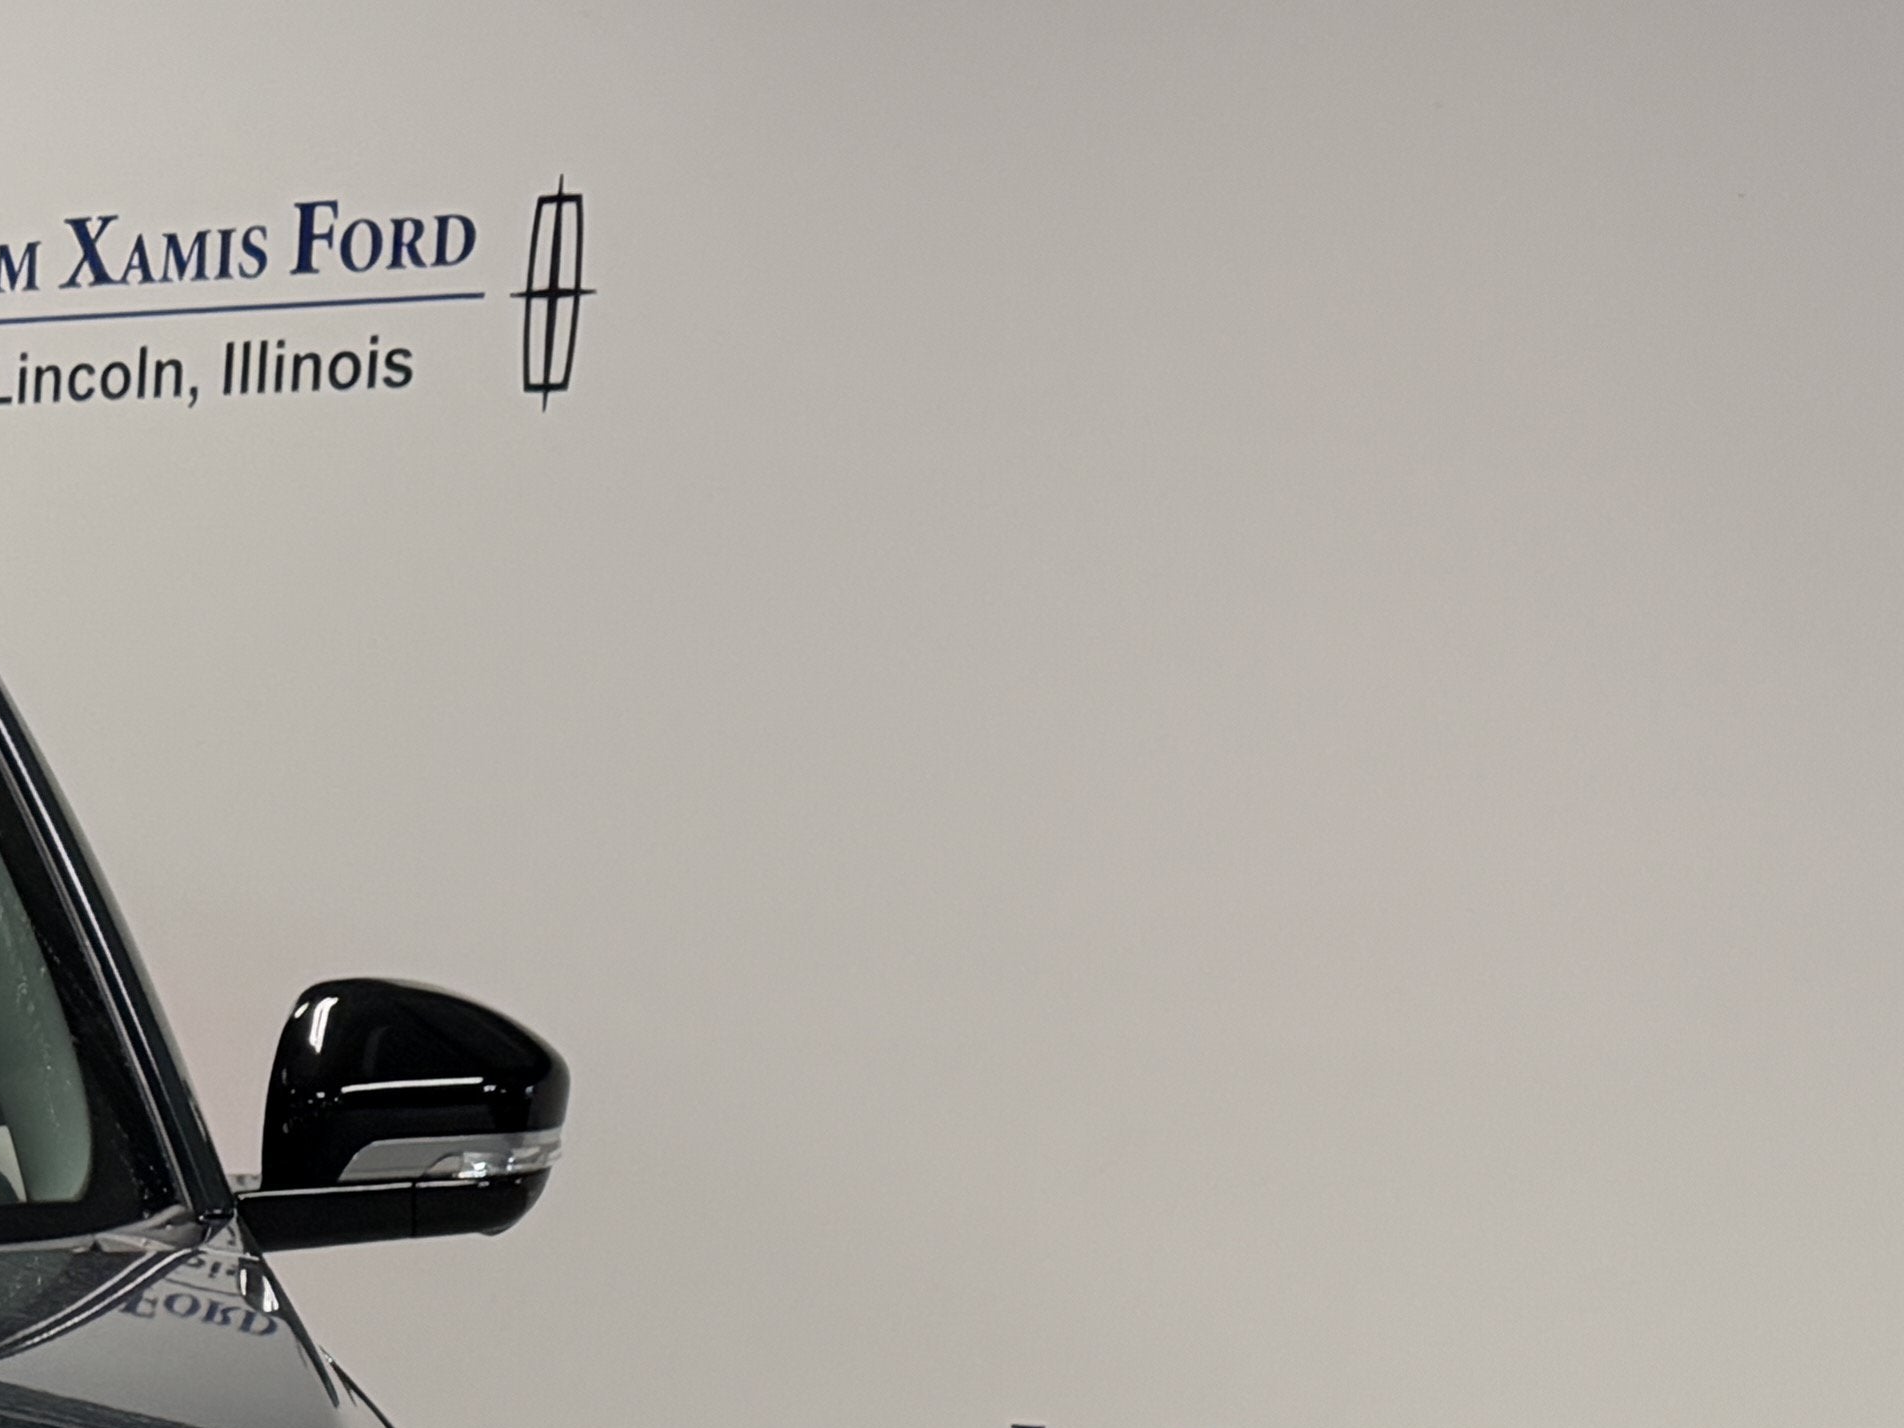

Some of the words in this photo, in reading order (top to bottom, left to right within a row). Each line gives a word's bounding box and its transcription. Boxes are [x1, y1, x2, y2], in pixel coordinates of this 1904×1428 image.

[58, 215, 269, 290] XAMIS
[289, 200, 478, 276] FORD
[223, 335, 415, 397] Illinois
